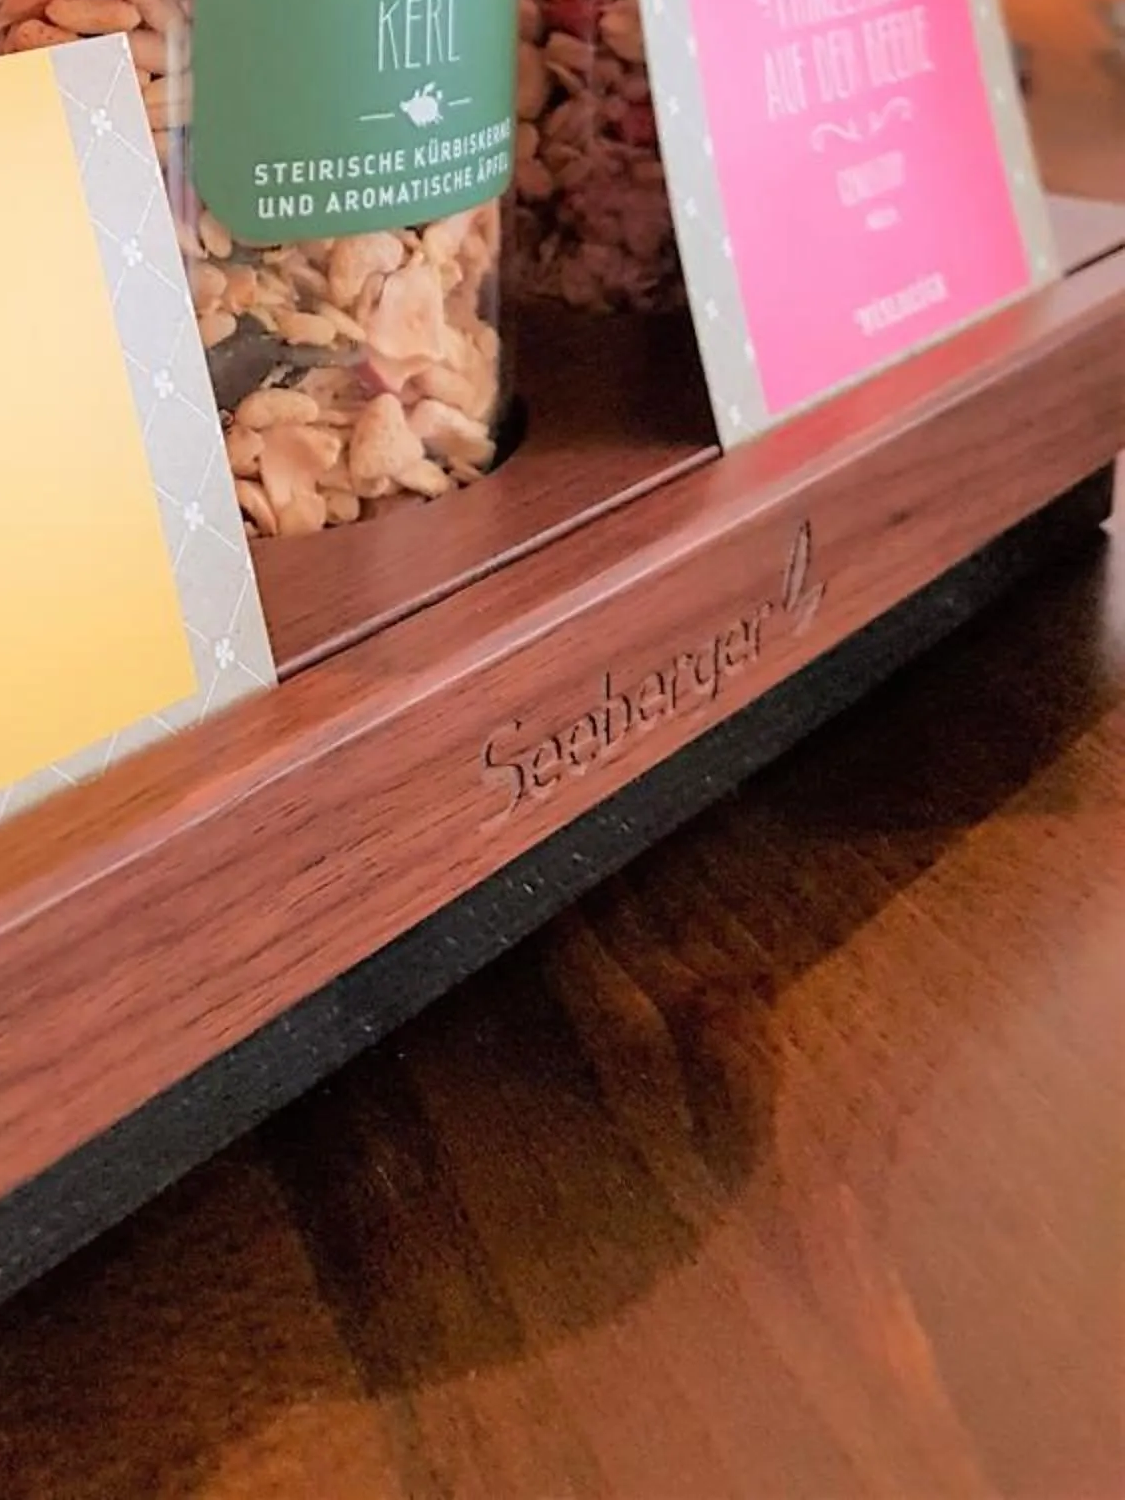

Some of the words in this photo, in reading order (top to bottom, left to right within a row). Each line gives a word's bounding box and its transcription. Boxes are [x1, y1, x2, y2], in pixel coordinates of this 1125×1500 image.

[254, 148, 406, 186] STEIRISCHE
[258, 193, 314, 220] UND
[325, 165, 473, 214] AROMATISCHE
[479, 601, 774, 834] Seeberger
